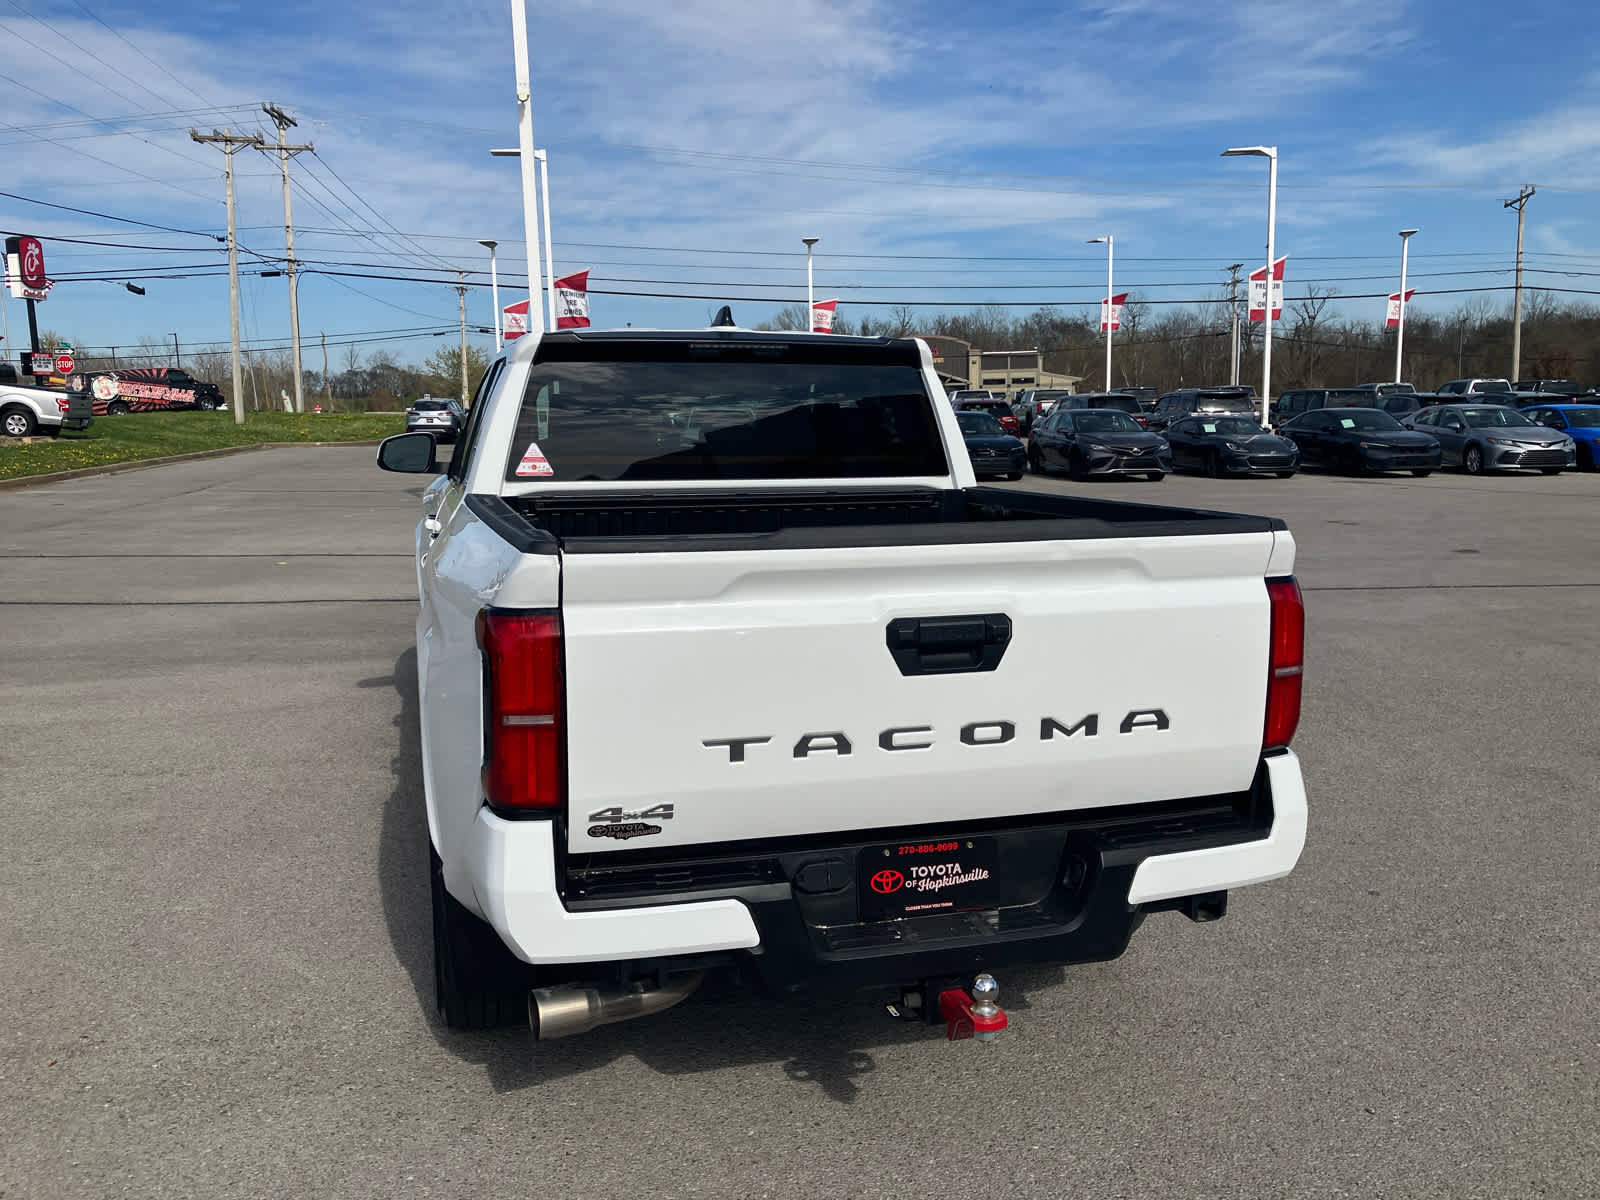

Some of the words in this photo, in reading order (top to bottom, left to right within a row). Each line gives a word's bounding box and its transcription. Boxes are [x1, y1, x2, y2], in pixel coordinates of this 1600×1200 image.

[57, 360, 73, 369] STOP
[702, 708, 1170, 763] TACOMA
[589, 804, 673, 823] 4x4
[905, 880, 917, 888] OF
[917, 868, 989, 892] Hopkinsville
[910, 863, 962, 878] TOYOTA
